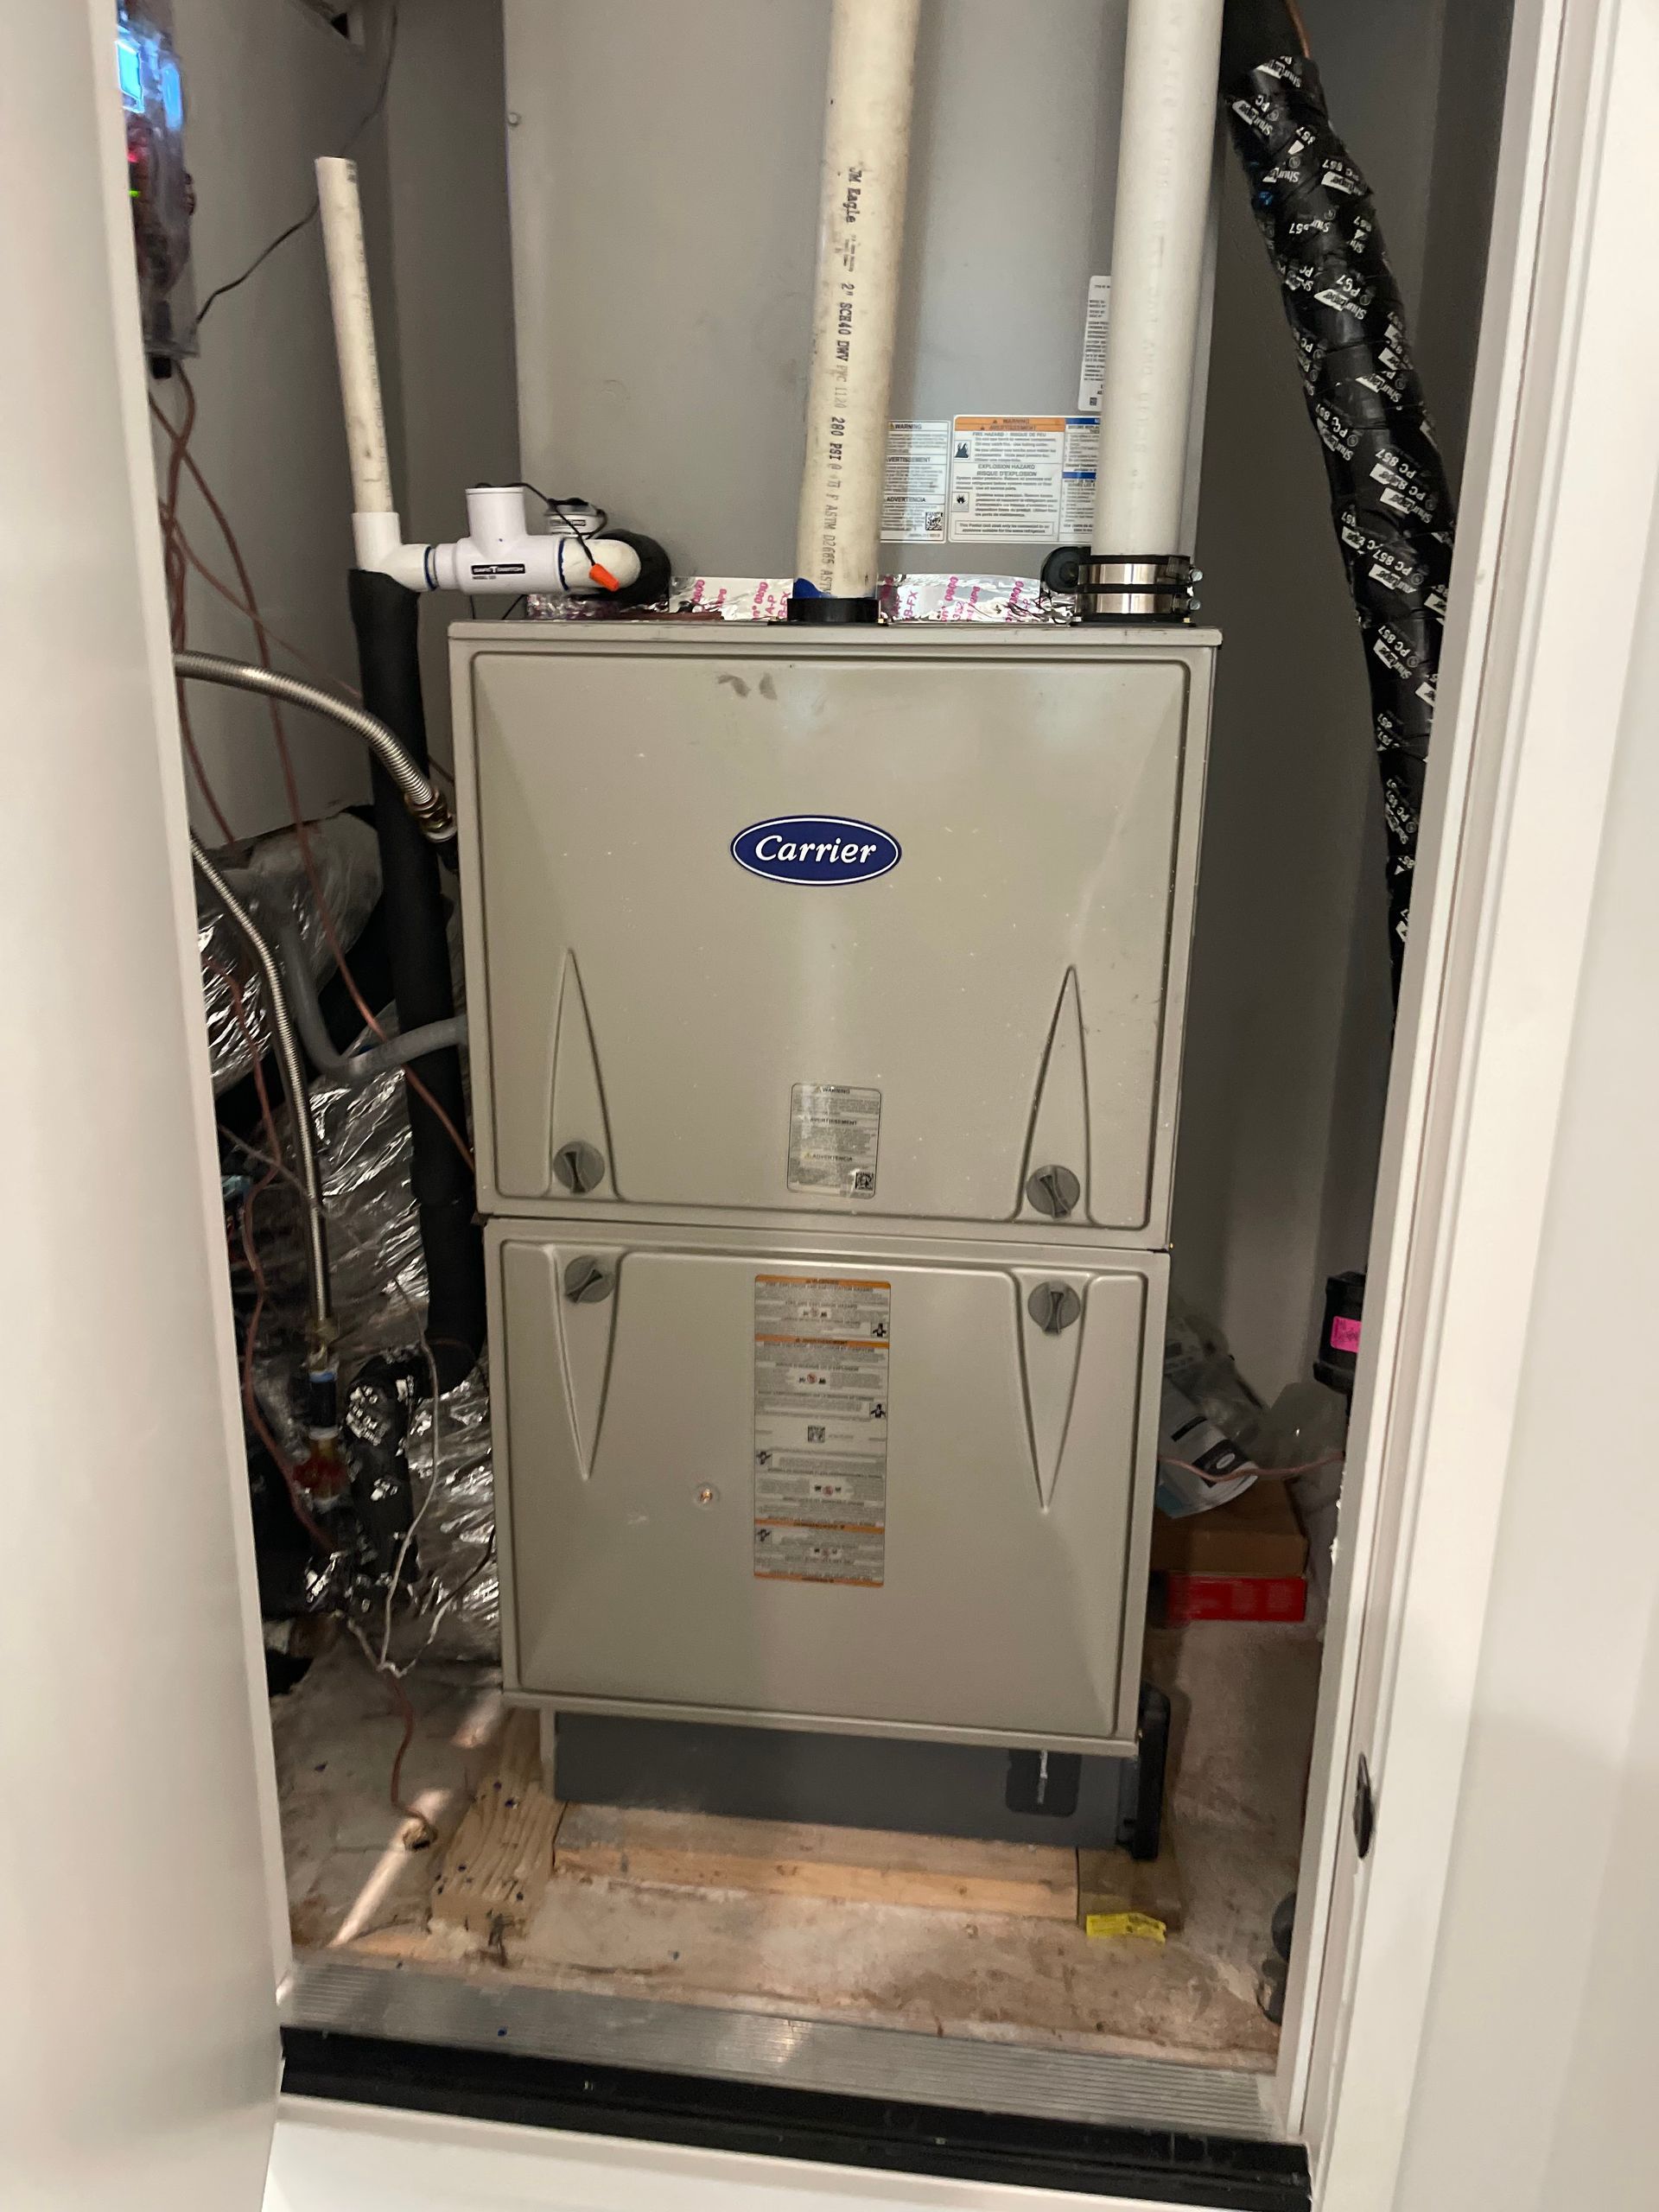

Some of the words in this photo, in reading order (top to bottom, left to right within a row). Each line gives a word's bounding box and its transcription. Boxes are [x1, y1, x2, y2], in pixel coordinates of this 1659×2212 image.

[842, 188, 861, 223] Eagle
[841, 283, 855, 296] 2"
[837, 302, 854, 335] SCH40
[836, 340, 850, 362] DWV
[830, 416, 846, 436] 280
[829, 442, 842, 461] PSI
[1375, 448, 1400, 467] 857
[1398, 463, 1417, 480] PC
[1408, 486, 1426, 500] PC
[823, 505, 838, 530] ASTM
[1372, 550, 1395, 567] 857
[1394, 560, 1414, 576] PC
[1377, 624, 1397, 645] 857
[1393, 640, 1412, 658] PC
[755, 835, 877, 864] Carrier
